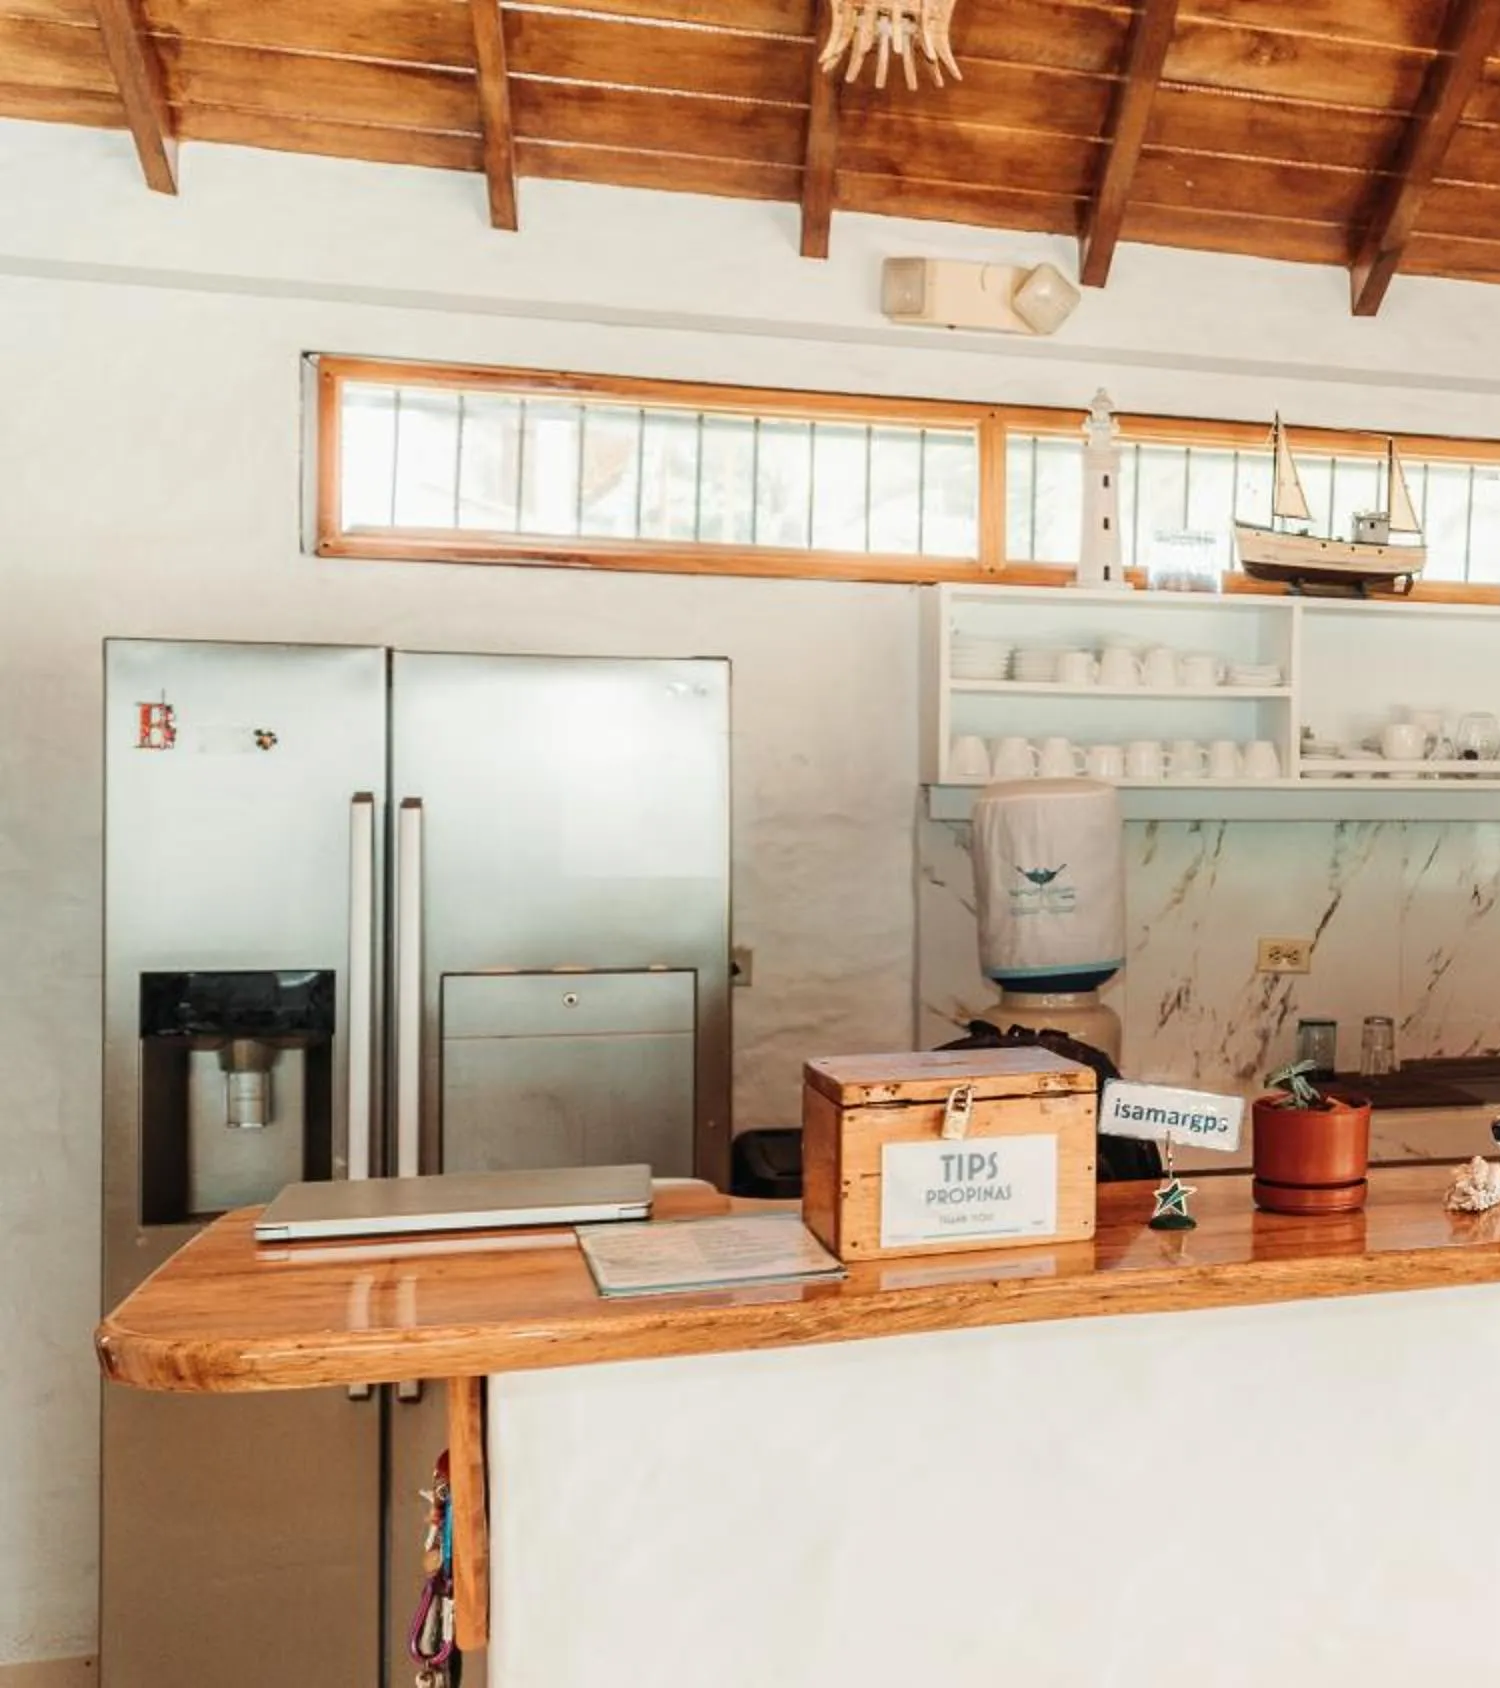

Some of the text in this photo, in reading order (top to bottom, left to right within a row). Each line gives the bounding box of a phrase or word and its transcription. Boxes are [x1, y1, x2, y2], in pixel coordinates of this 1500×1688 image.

[1113, 1097, 1230, 1134] isamargps
[939, 1151, 999, 1182] TIPS
[925, 1183, 1012, 1205] PROPINAS
